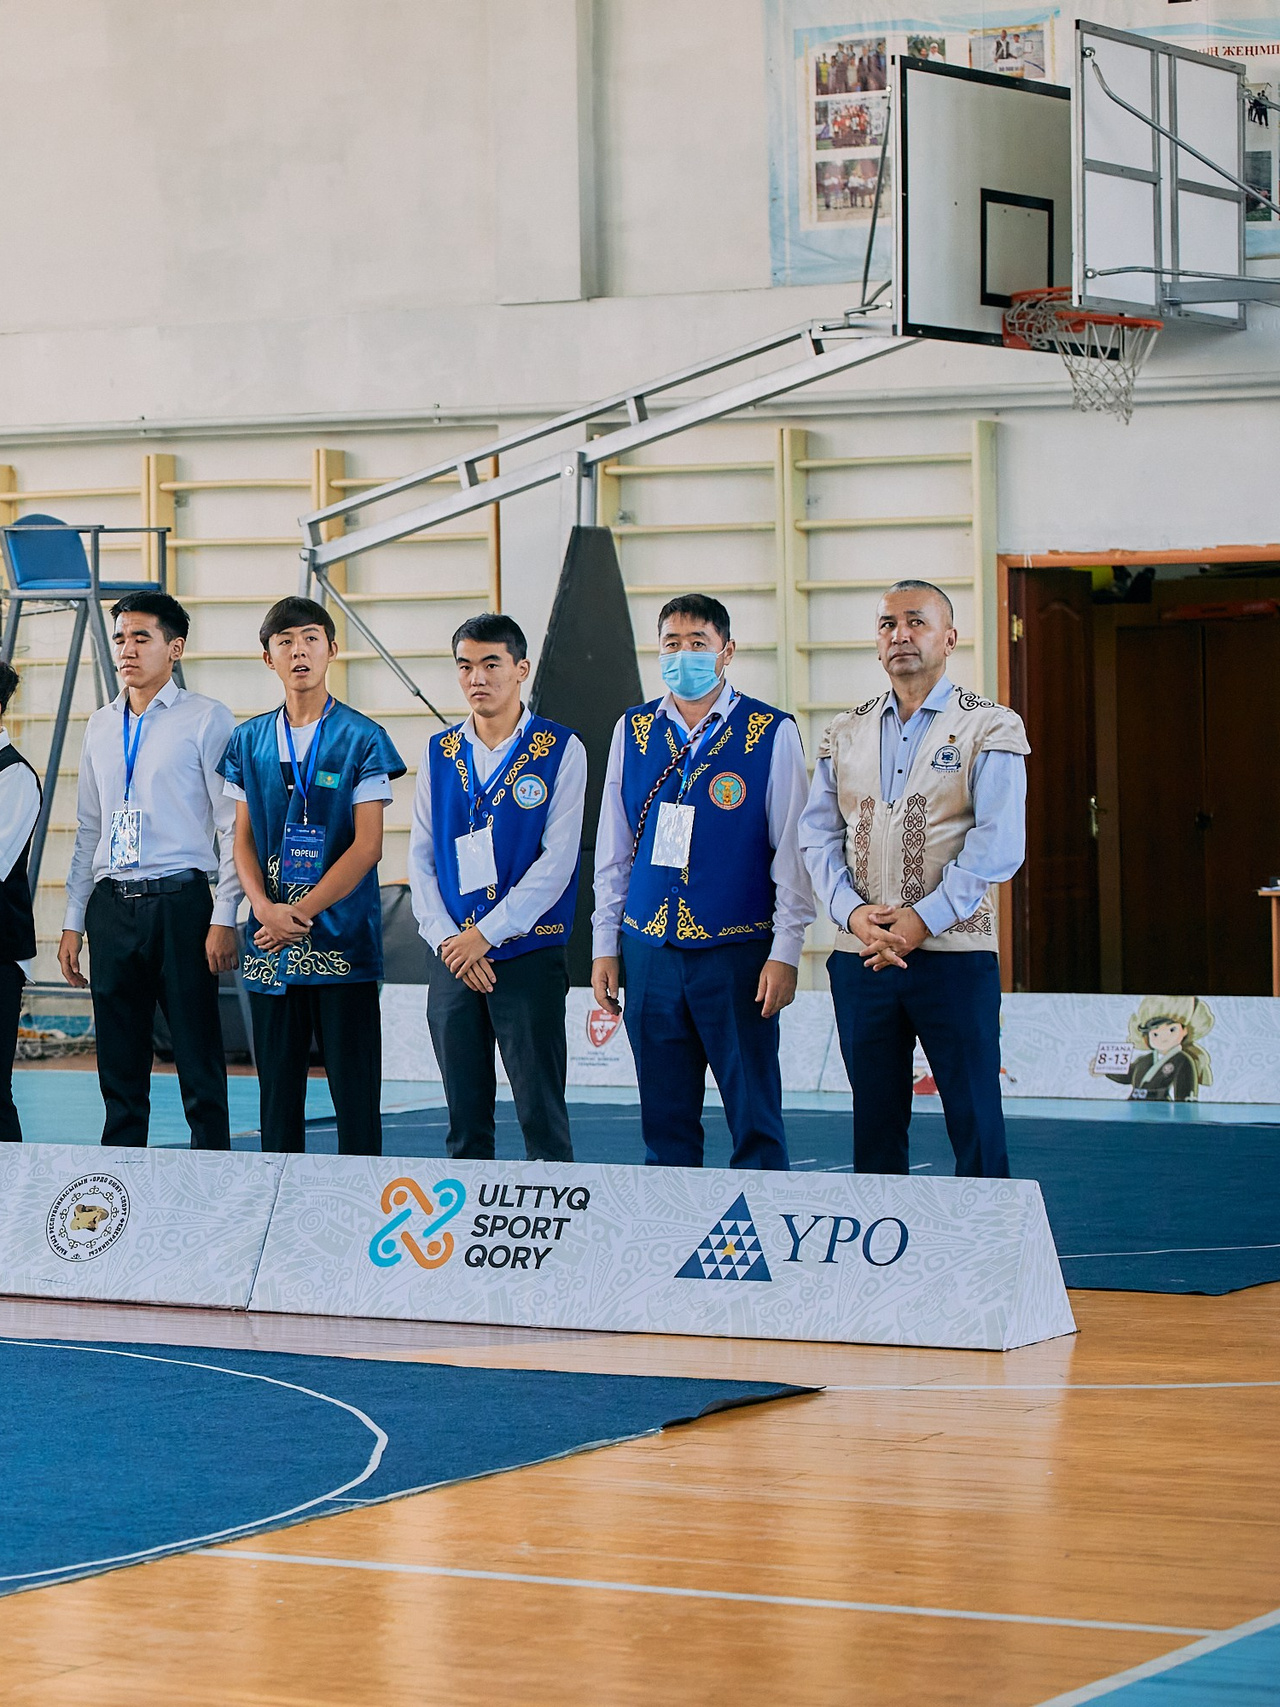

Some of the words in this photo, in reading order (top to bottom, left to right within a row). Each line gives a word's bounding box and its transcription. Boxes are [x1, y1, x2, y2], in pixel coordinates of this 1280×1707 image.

[1098, 1053, 1129, 1065] 8-13
[478, 1184, 590, 1211] ULTTYQ
[470, 1214, 571, 1240] SPORT
[779, 1214, 909, 1267] YPO
[464, 1244, 553, 1270] QORY
